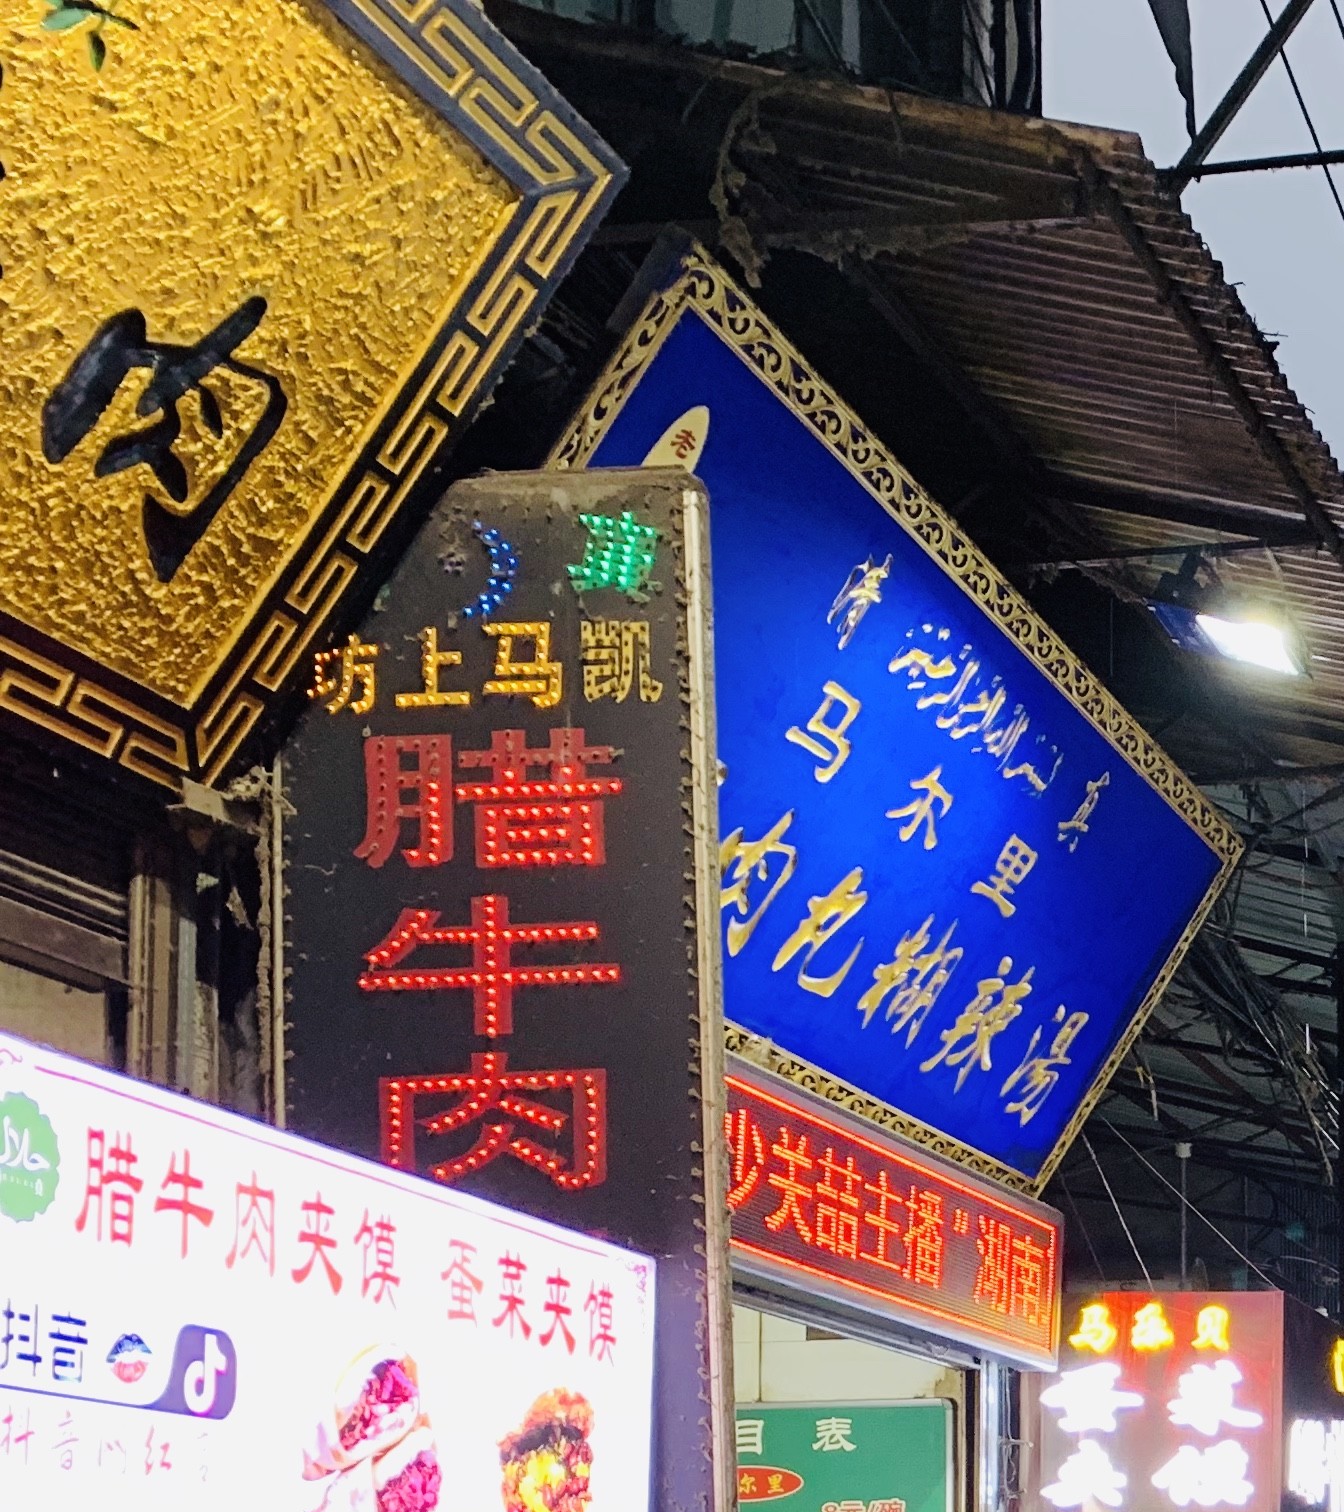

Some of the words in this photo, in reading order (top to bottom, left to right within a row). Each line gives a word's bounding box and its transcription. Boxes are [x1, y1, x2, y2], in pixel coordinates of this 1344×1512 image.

[352, 727, 623, 1190] 腊牛肉
[75, 1126, 402, 1310] 腊牛肉夹馍
[440, 1239, 618, 1369] 蛋菜夹馍
